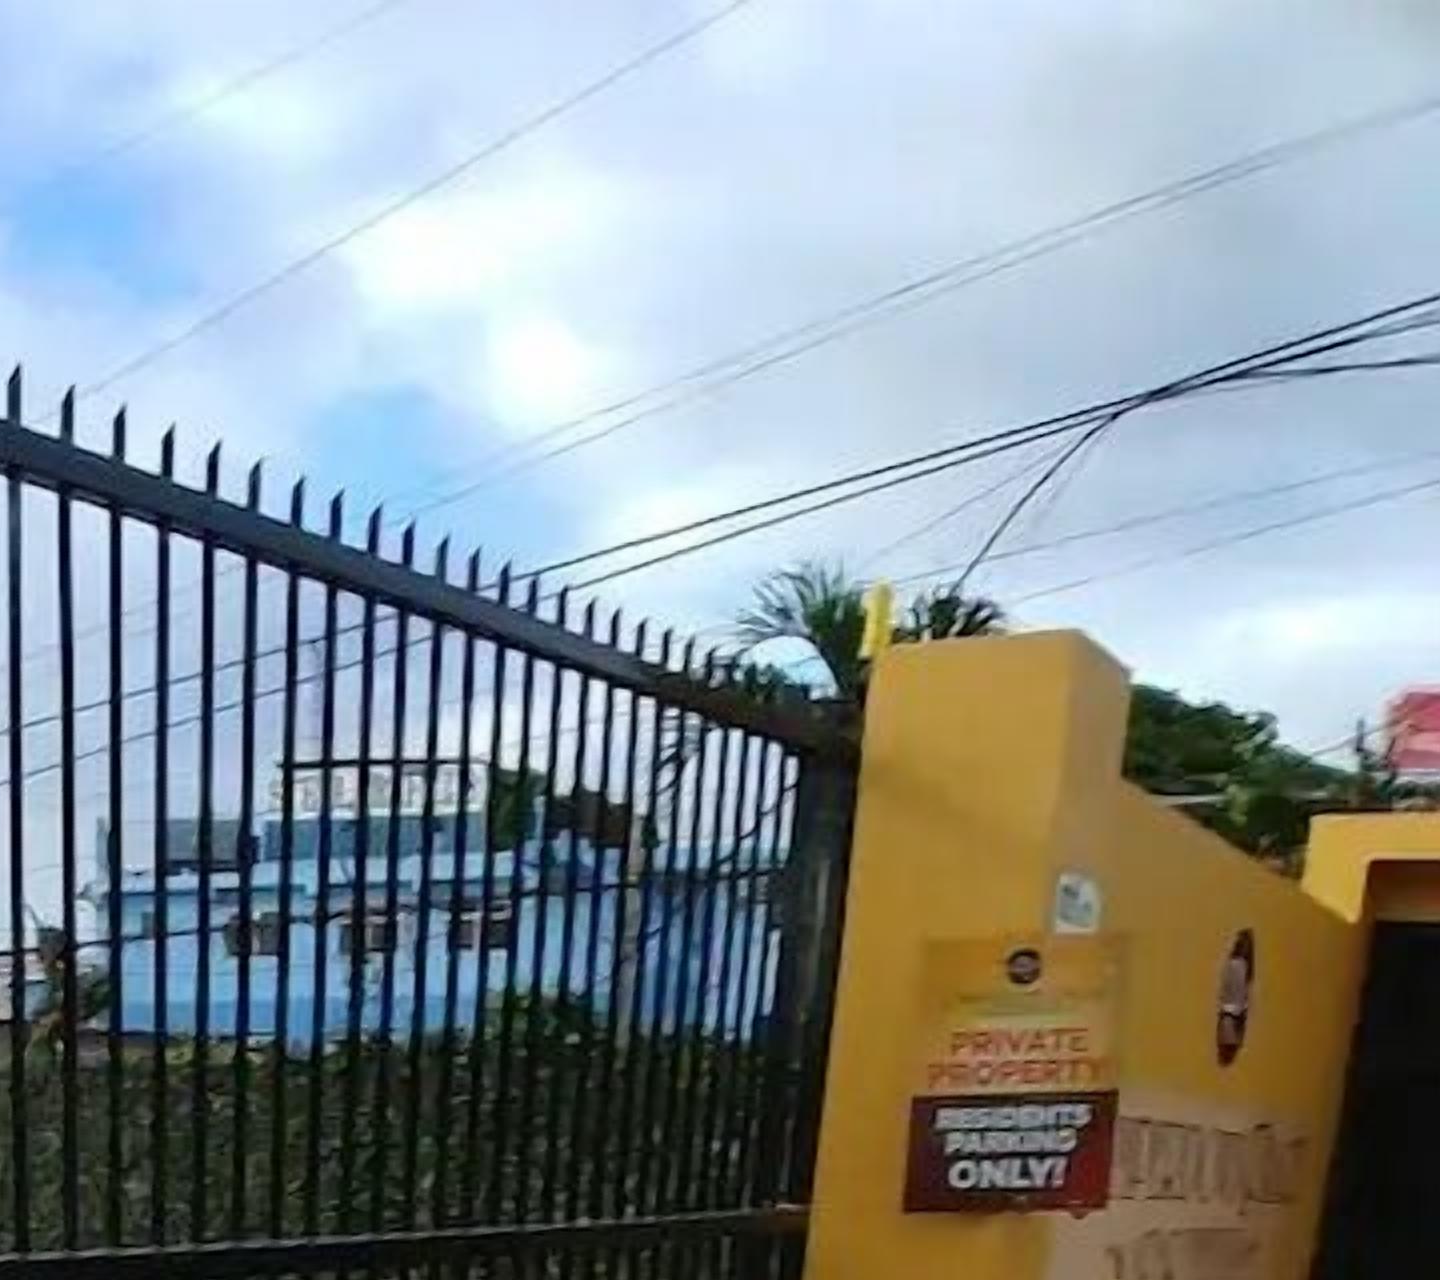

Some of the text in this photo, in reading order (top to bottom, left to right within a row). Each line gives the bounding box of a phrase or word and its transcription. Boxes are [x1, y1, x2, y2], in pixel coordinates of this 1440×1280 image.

[951, 1028, 1088, 1056] PRIVATE
[928, 1058, 1109, 1087] PROPERTY
[945, 1128, 1077, 1153] PARKING
[948, 1157, 1068, 1189] ONLY!
